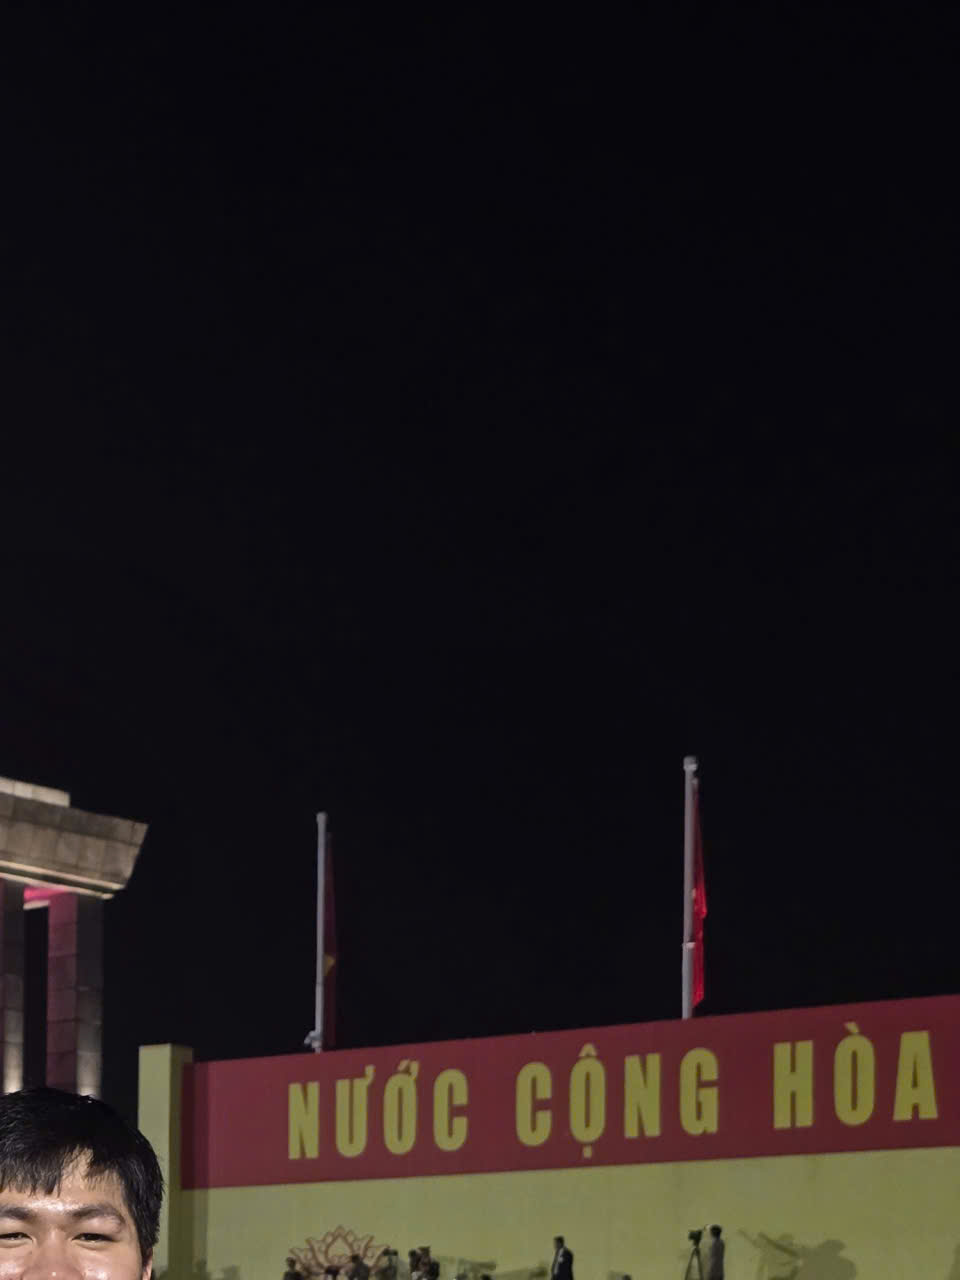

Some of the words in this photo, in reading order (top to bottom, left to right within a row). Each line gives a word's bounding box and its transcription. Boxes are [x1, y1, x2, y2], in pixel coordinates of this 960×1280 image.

[288, 1059, 468, 1160] NƯỚC
[516, 1043, 720, 1158] CỘNG
[773, 1022, 938, 1129] HÒA
